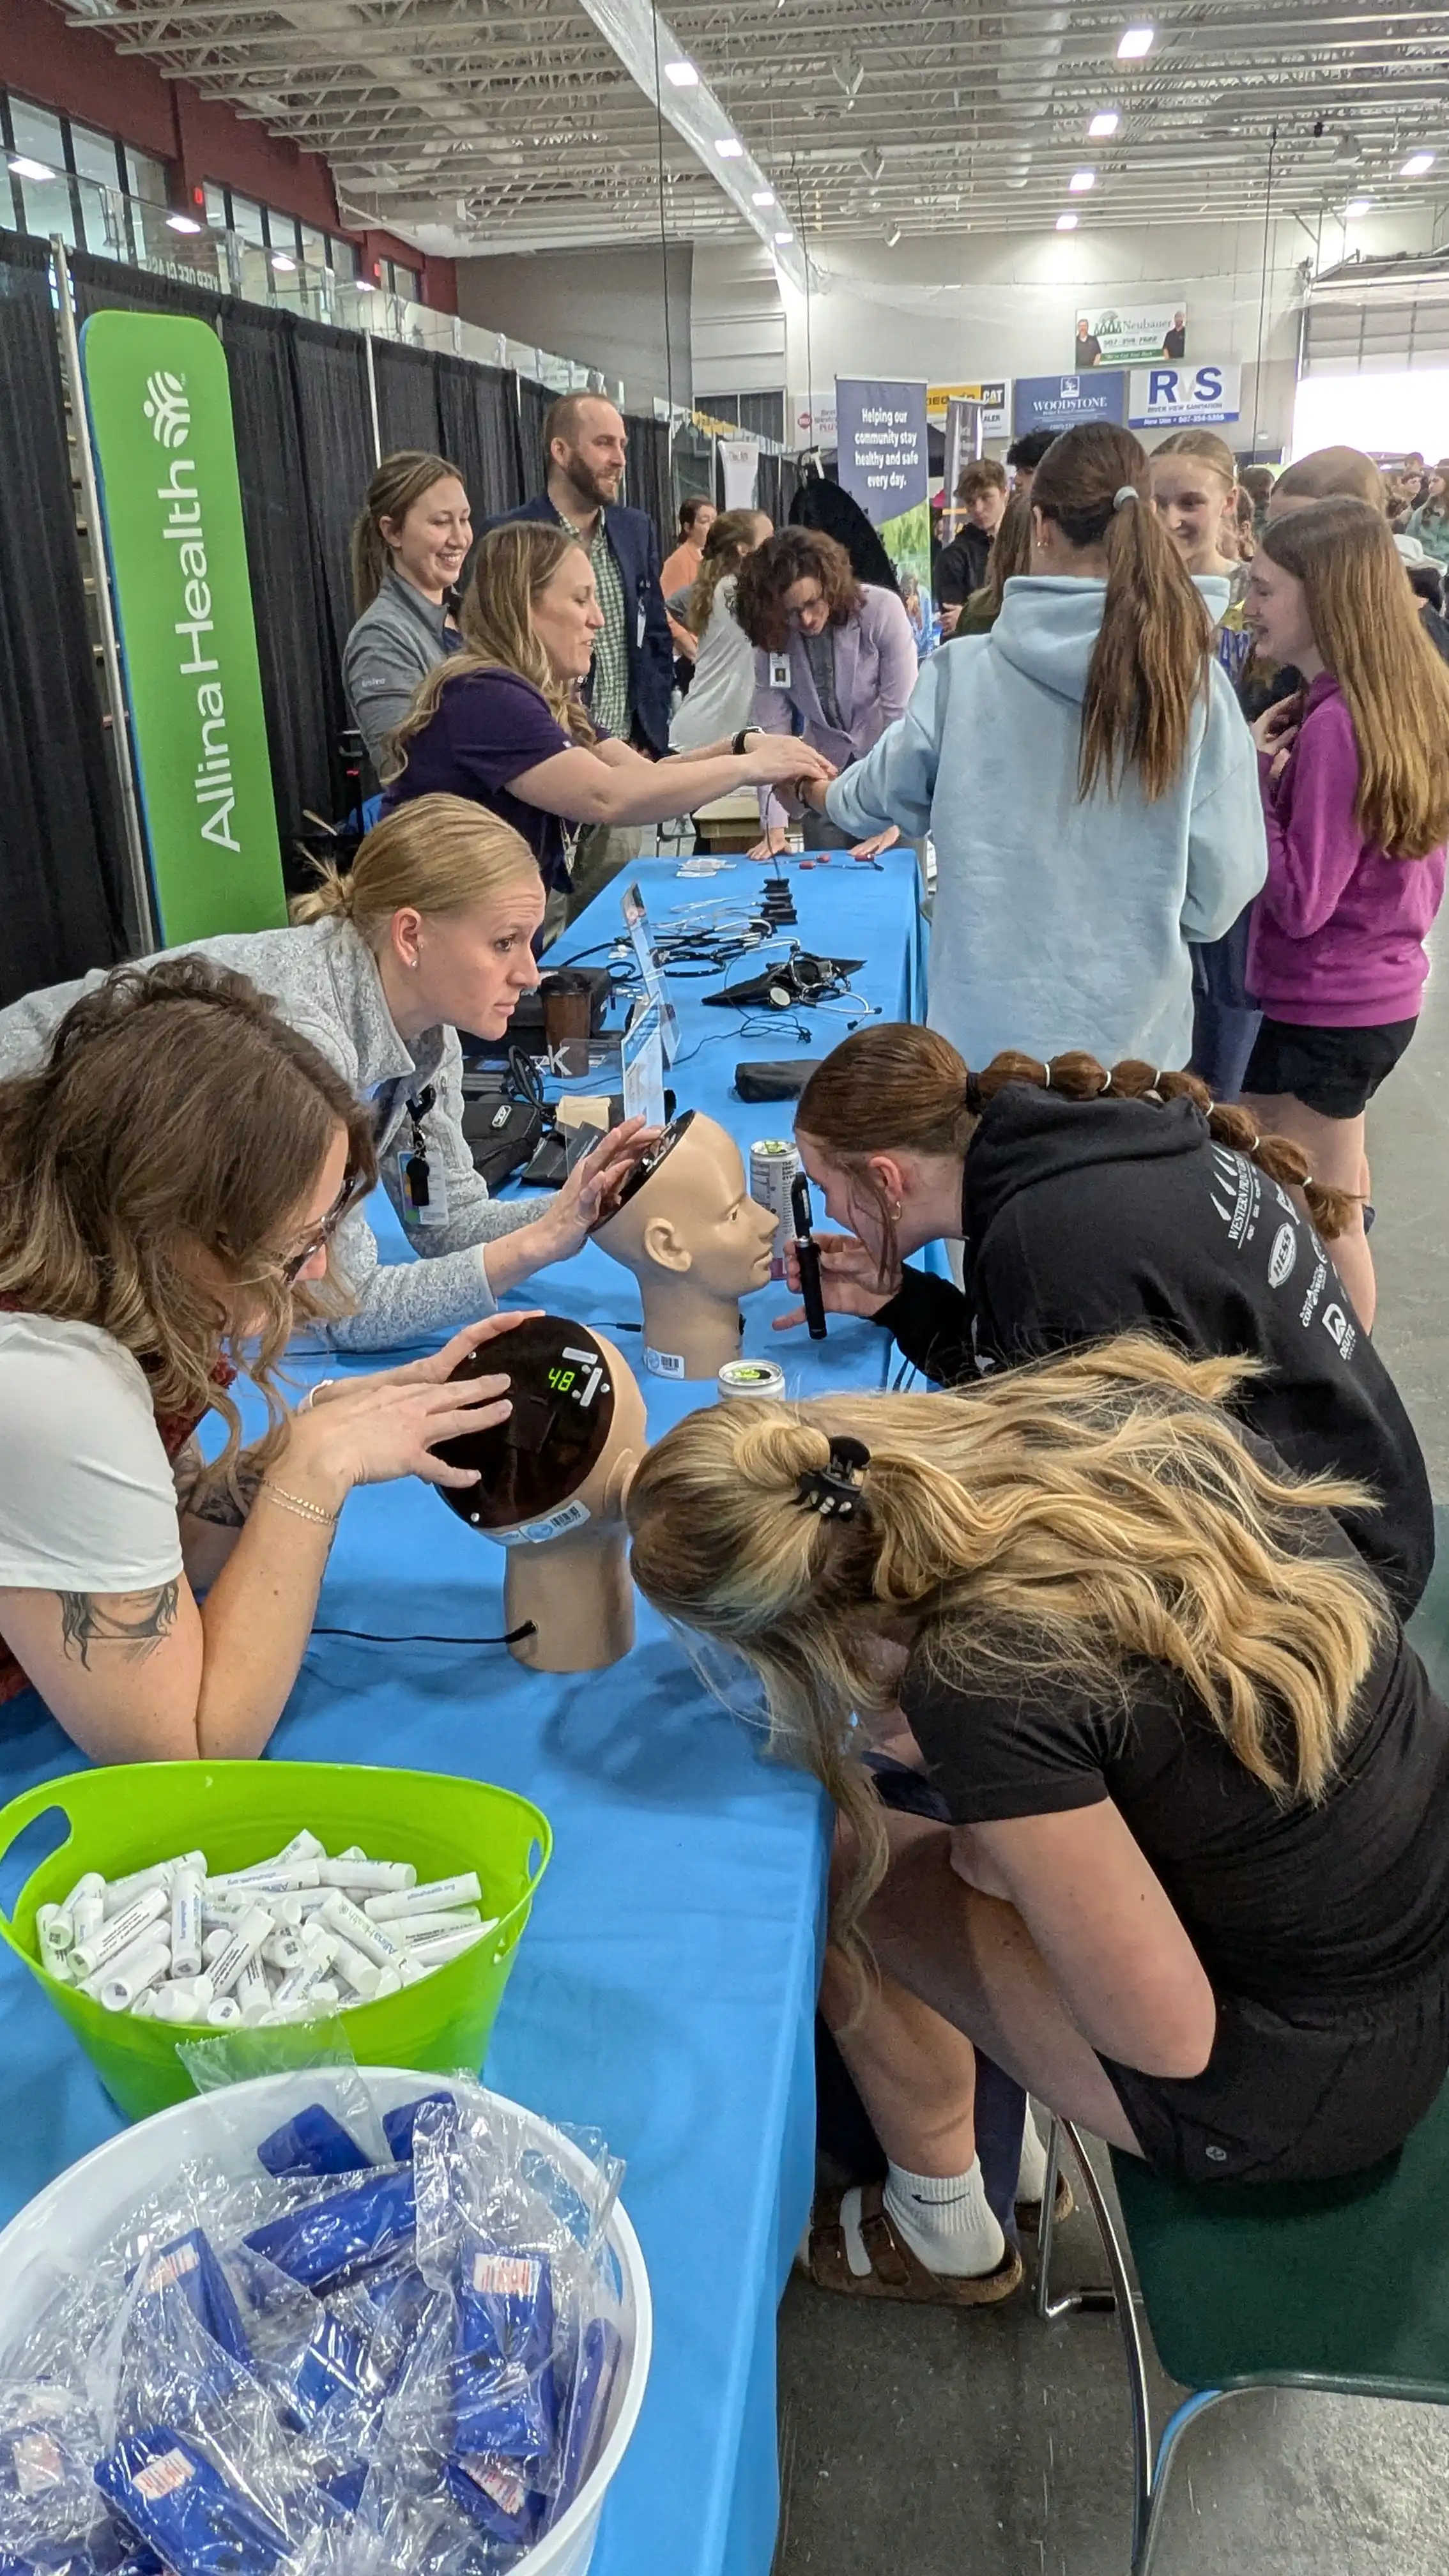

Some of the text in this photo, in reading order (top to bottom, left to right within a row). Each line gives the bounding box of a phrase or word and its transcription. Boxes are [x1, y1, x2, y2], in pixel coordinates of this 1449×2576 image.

[1123, 318, 1172, 330] Neubauer
[1149, 367, 1222, 404] RVS
[983, 390, 1003, 404] CAT
[1033, 396, 1107, 411] WOODSTONE
[862, 408, 908, 427] Helping our
[855, 429, 917, 447] community stay
[855, 450, 919, 470] healthy and safe
[867, 471, 907, 490] every day.
[158, 461, 240, 852] Allina Health
[1228, 1190, 1249, 1241] WESTERN
[1273, 1232, 1291, 1278] HESS
[548, 1367, 576, 1392] 48
